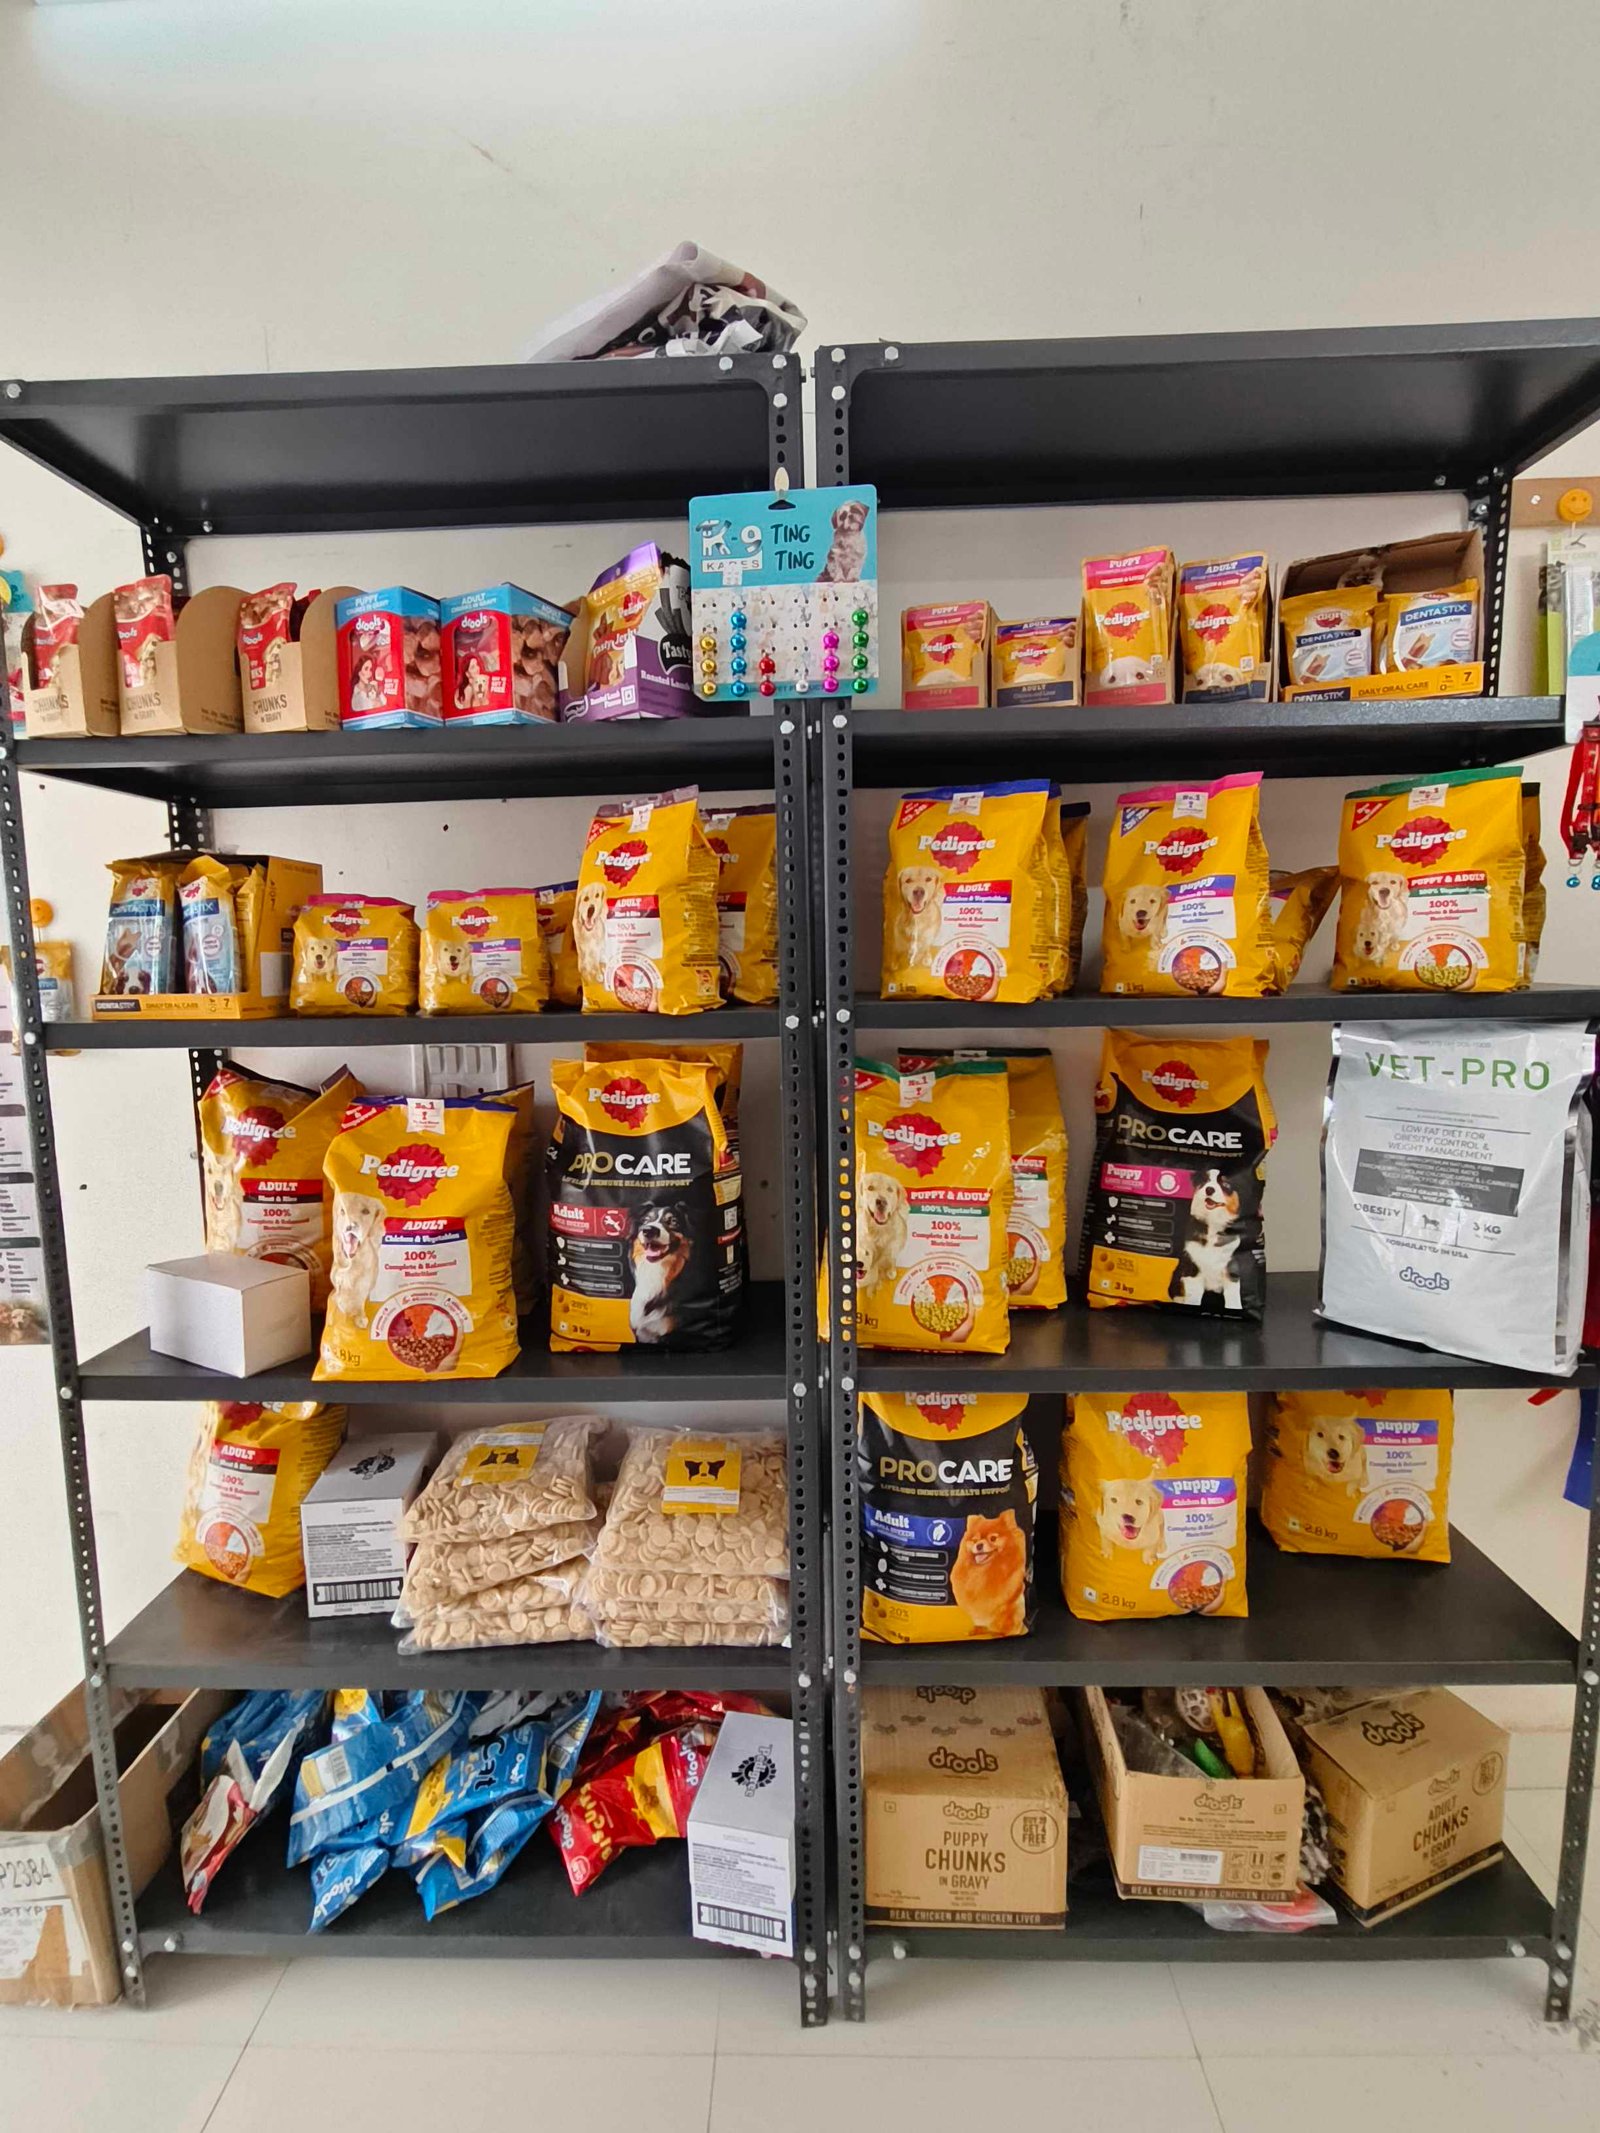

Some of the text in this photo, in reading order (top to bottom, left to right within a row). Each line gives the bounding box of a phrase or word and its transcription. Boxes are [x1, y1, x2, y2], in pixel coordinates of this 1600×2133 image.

[771, 523, 810, 544] TING
[775, 551, 815, 571] TING
[1109, 556, 1141, 568] PUPPY
[1205, 562, 1238, 573] ADULT
[462, 593, 486, 605] ADULT
[931, 606, 958, 615] PUPPY
[1405, 604, 1467, 622] DENTASTIX
[356, 614, 382, 630] drools
[461, 612, 487, 628] drools
[1022, 620, 1050, 629] ADULT
[1096, 611, 1150, 626] Pedigree
[1188, 615, 1240, 630] Pedigree
[1301, 630, 1357, 644] DENTASTIX
[921, 642, 964, 653] Pedigree
[1010, 647, 1057, 660] Pedigree
[1294, 672, 1472, 701] DENTASTIX DAILY ORAL CARE 7
[125, 692, 162, 711] CHUNKS
[253, 694, 288, 715] CHUNKS
[918, 835, 996, 855] Pedigree
[1375, 828, 1467, 849] Pedigree
[1144, 836, 1219, 858] Pedigree
[1178, 877, 1216, 894] puppy
[1411, 873, 1486, 886] PUPPY ADULT
[956, 883, 992, 893] ADULT
[959, 907, 984, 916] 100%
[1182, 902, 1206, 911] 100%
[1429, 900, 1458, 908] 100%
[323, 915, 371, 927] Pedigree
[451, 914, 498, 926] Pedigree
[1365, 1051, 1550, 1091] VET-PRO
[1141, 1070, 1210, 1091] Pedigree
[588, 1087, 661, 1109] Pedigree
[222, 1116, 297, 1141] Pedigree
[868, 1119, 961, 1151] Pedigree
[1401, 1125, 1486, 1140] LOW FAT DIET FOR
[1394, 1133, 1490, 1151] OBESITY CONTROL &
[1388, 1141, 1493, 1161] WEIGHT MANAGEMENT
[360, 1154, 460, 1182] Pedigree
[1107, 1164, 1142, 1180] Puppy
[258, 1181, 298, 1191] ADULT
[910, 1190, 990, 1201] PUPPY & ADULT
[263, 1208, 291, 1216] 100%
[553, 1204, 585, 1220] Adult
[920, 1205, 982, 1215] 100% Vegetarian
[1354, 1203, 1400, 1217] OBESITY
[402, 1219, 447, 1231] ADULT
[931, 1220, 961, 1231] 100%
[1484, 1224, 1502, 1234] KG
[384, 1232, 460, 1243] Chicken Vegetables
[912, 1233, 943, 1241] Complete
[404, 1251, 437, 1261] 100%
[1440, 1248, 1450, 1256] IN
[1451, 1250, 1469, 1259] USA
[384, 1260, 457, 1271] Complete Balanced
[404, 1270, 438, 1278] Nutrition
[1400, 1266, 1450, 1290] drools
[1122, 1283, 1134, 1294] kg
[864, 1313, 878, 1329] kg
[579, 1326, 591, 1336] kg
[348, 1352, 361, 1366] kg
[905, 1392, 978, 1409] Pedigree
[1105, 1410, 1203, 1436] Pedigree
[1376, 1421, 1420, 1434] puppy
[221, 1445, 256, 1460] ADULT
[1386, 1451, 1412, 1460] 100%
[879, 1456, 1014, 1483] PROCARE
[222, 1474, 245, 1486] 100%
[1173, 1479, 1220, 1494] puppy
[875, 1509, 910, 1529] Adult
[1185, 1513, 1214, 1523] 100%
[1167, 1524, 1197, 1532] Complete
[1304, 1523, 1338, 1541] 2.8 kg
[1102, 1593, 1137, 1610] 2.8 kg
[917, 1686, 976, 1705] drools
[1362, 1710, 1425, 1746] drools
[929, 1746, 999, 1774] drools
[744, 1744, 774, 1798] Pedigree
[1194, 1793, 1244, 1811] drools
[1428, 1796, 1458, 1822] ADULT
[943, 1801, 990, 1821] drools
[554, 1805, 574, 1849] drools
[1023, 1824, 1038, 1834] GET
[1413, 1806, 1470, 1851] CHUNKS
[943, 1831, 989, 1847] PUPPY
[1022, 1833, 1047, 1844] FREE
[925, 1849, 1006, 1874] CHUNKS
[939, 1875, 989, 1890] IN GRAVY
[314, 1876, 354, 1918] drools
[1131, 1886, 1153, 1896] REAL
[1156, 1887, 1196, 1898] CHICKEN
[889, 1909, 1041, 1924] REAL CHICKEN AND CHICKEN LIVER
